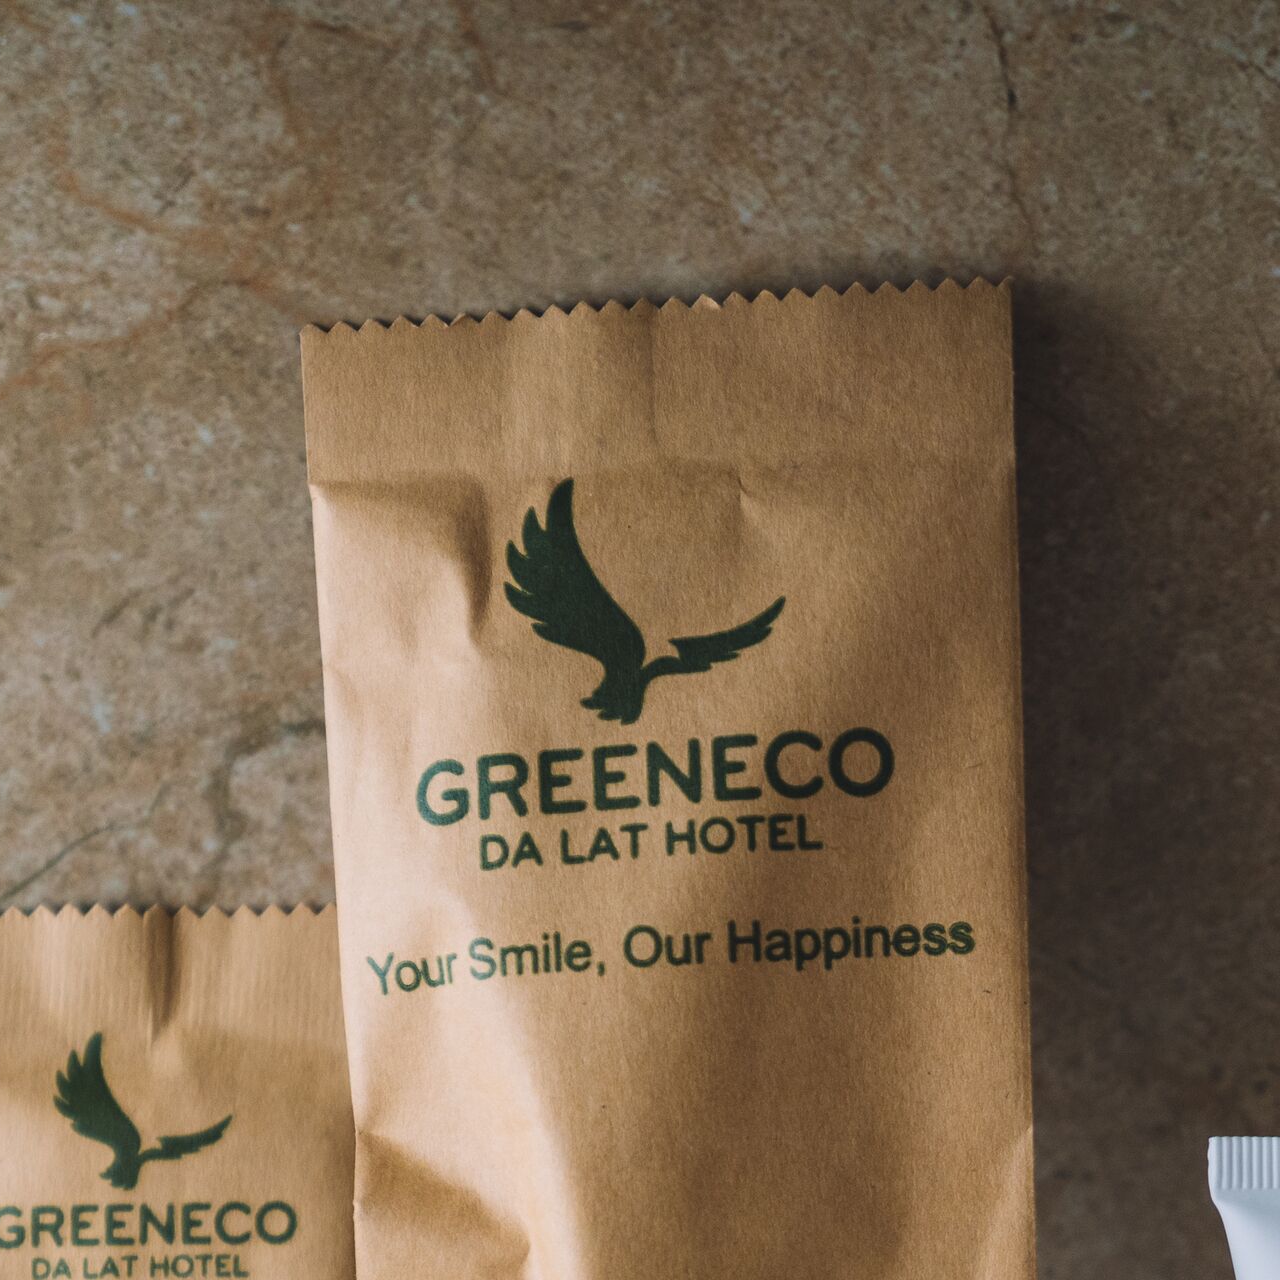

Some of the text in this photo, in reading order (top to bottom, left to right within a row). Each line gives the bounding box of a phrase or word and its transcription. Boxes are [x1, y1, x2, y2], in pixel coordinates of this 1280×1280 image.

[416, 726, 895, 826] GREENECO
[480, 814, 824, 871] DA LAT HOTEL
[366, 917, 975, 995] Your Smile, Our Happiness
[32, 1254, 249, 1280] DA LAT HOTEL
